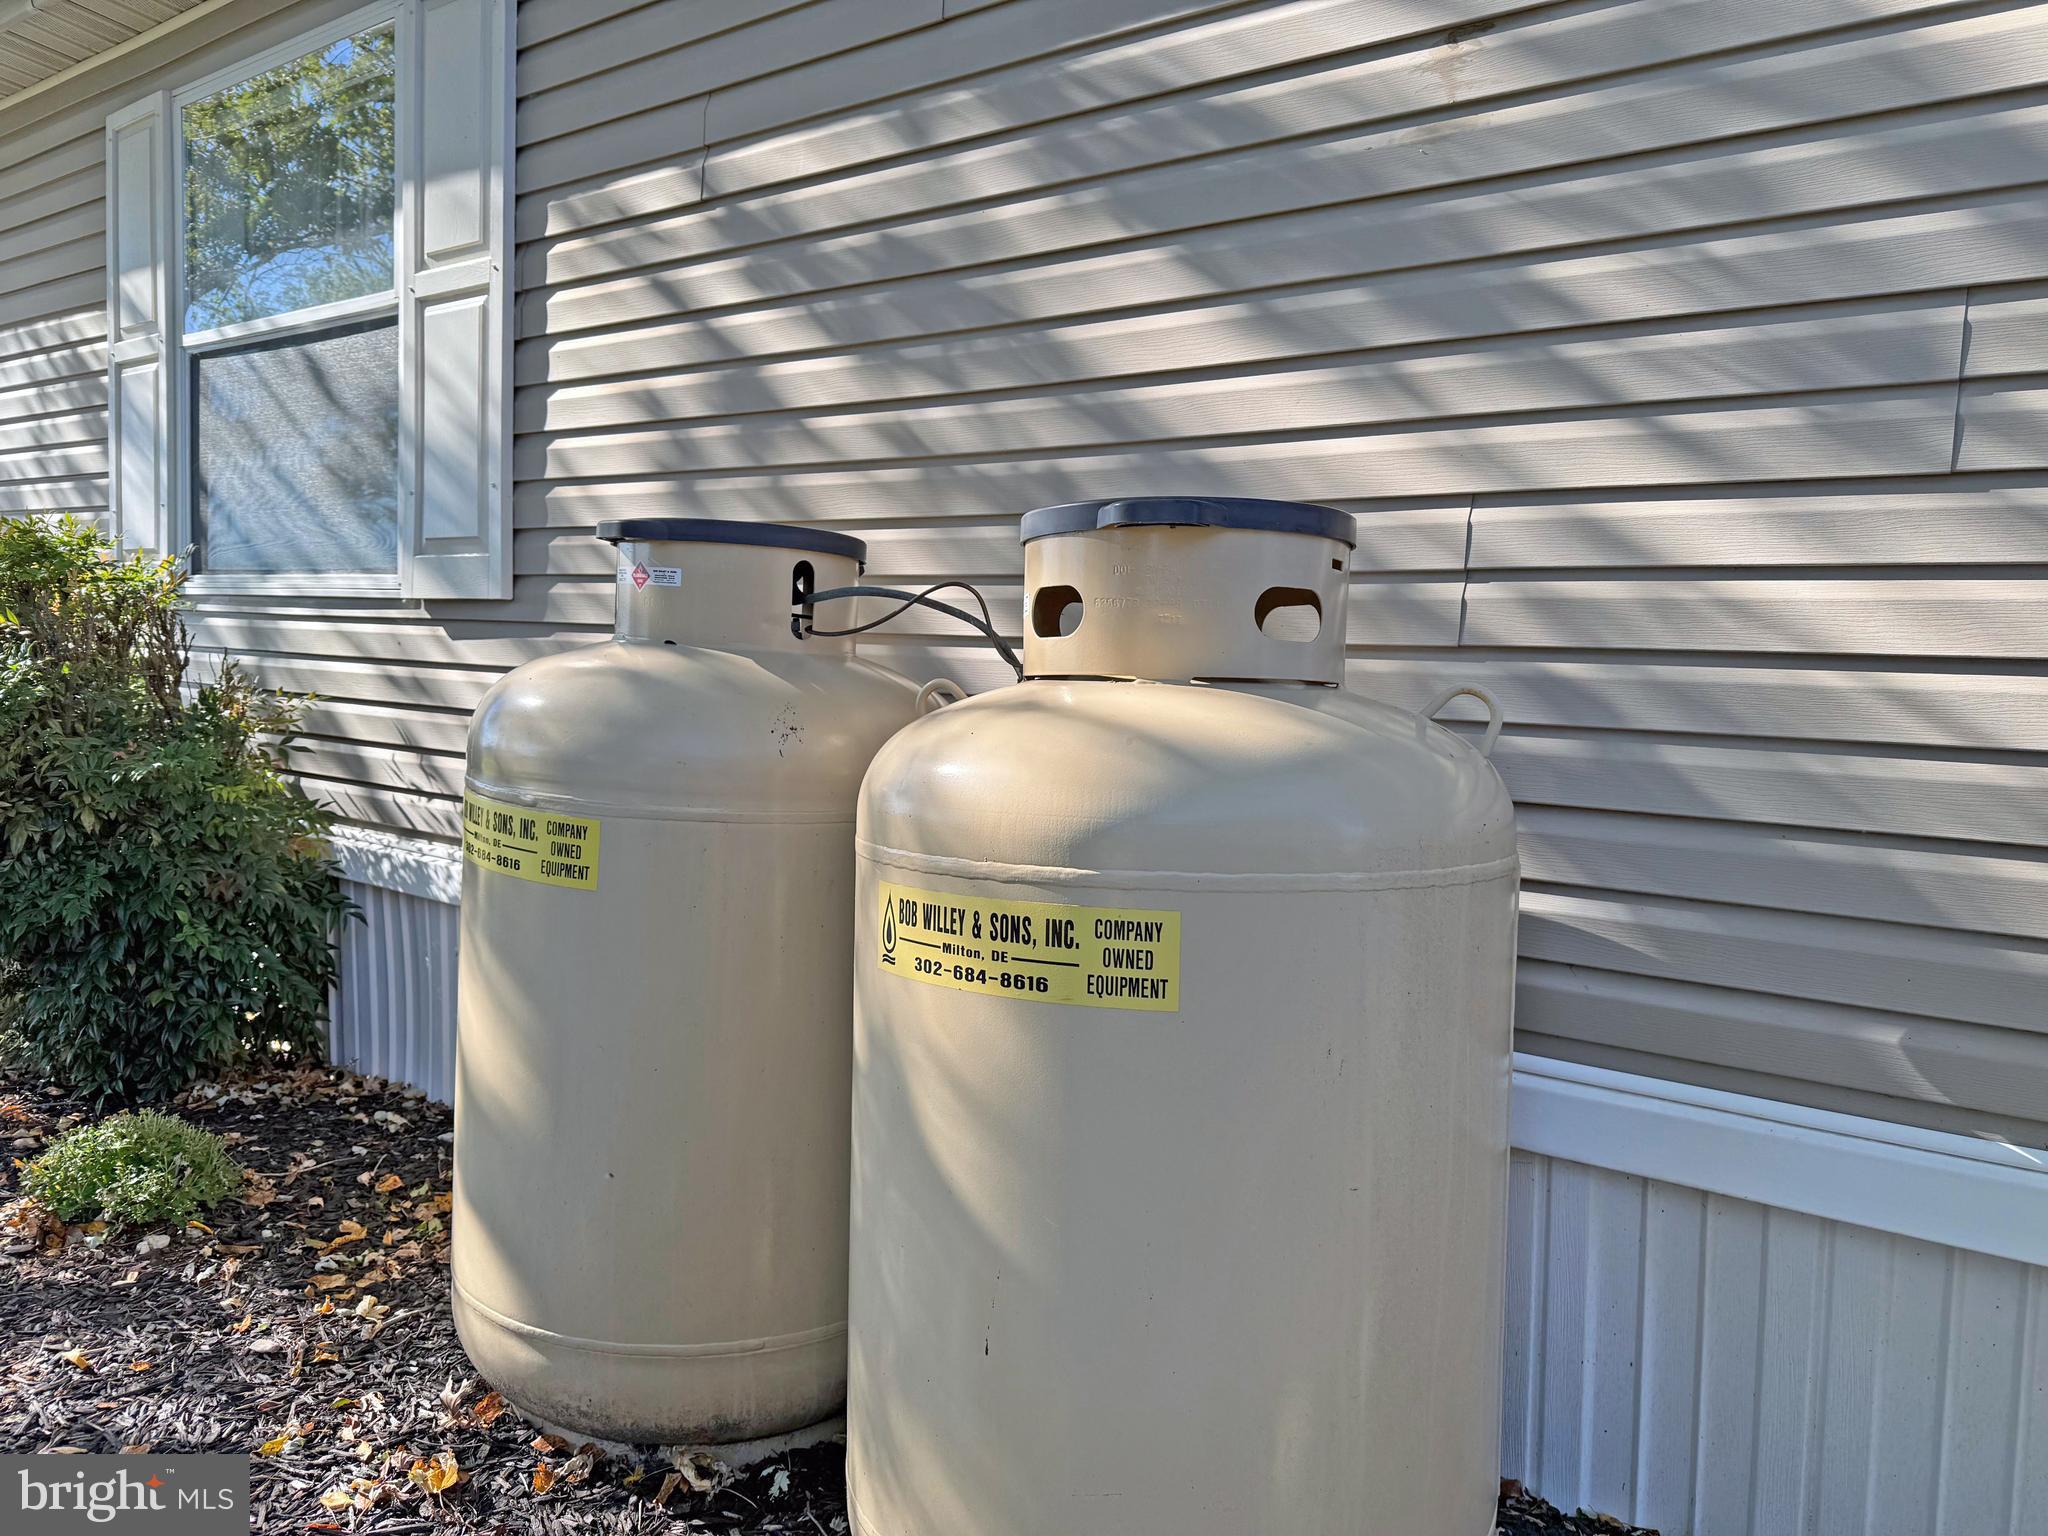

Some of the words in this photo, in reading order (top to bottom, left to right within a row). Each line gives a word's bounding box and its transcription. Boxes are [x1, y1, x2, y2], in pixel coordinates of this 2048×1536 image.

[493, 811, 516, 839] SONS,
[519, 817, 538, 841] INC.
[546, 820, 588, 840] COMPANY
[550, 841, 582, 860] OWNED
[541, 859, 590, 881] EQUIPMENT
[899, 898, 918, 928] BOB
[923, 903, 966, 937] WILLEY
[972, 910, 982, 939] &
[990, 912, 1037, 949] SONS,
[1045, 918, 1080, 949] INC.
[1094, 918, 1163, 943] COMPANY
[942, 942, 985, 961] Milton,
[992, 950, 1008, 963] DE
[1103, 947, 1154, 971] OWNED
[914, 957, 1049, 993] 302-684-8616
[1087, 974, 1169, 1000] EQUIPMENT
